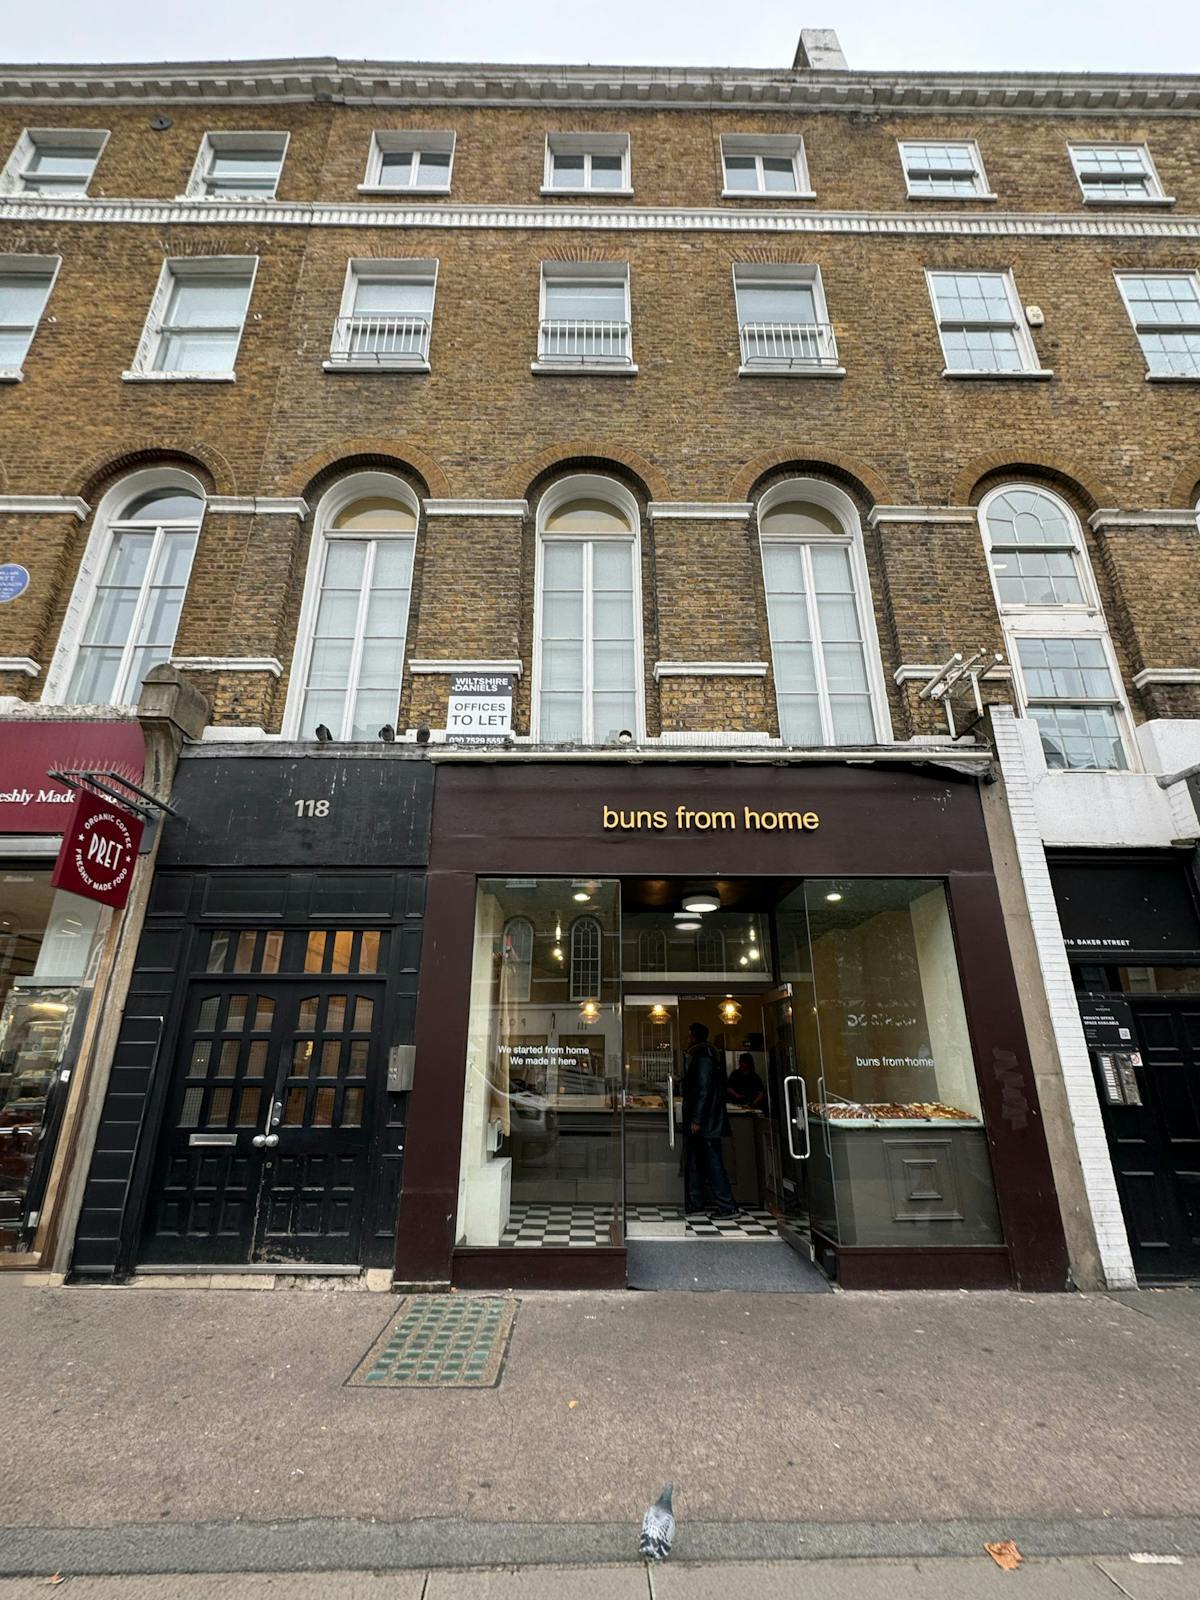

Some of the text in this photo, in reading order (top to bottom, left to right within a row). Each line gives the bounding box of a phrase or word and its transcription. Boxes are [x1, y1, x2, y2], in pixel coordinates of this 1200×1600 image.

[455, 677, 508, 686] WILTSHIRE
[455, 684, 498, 692] DANIELS
[454, 703, 506, 712] OFFICES
[452, 714, 508, 726] TO LET
[294, 799, 330, 817] 118
[603, 805, 820, 830] buns from home
[84, 813, 132, 849] ORGANIC COFFEE
[87, 832, 124, 871] PRET
[75, 848, 128, 891] FRESHLY MADE FOOD
[498, 1045, 590, 1055] We started from home
[510, 1056, 577, 1066] We made it here
[856, 1056, 934, 1067] buns from home
